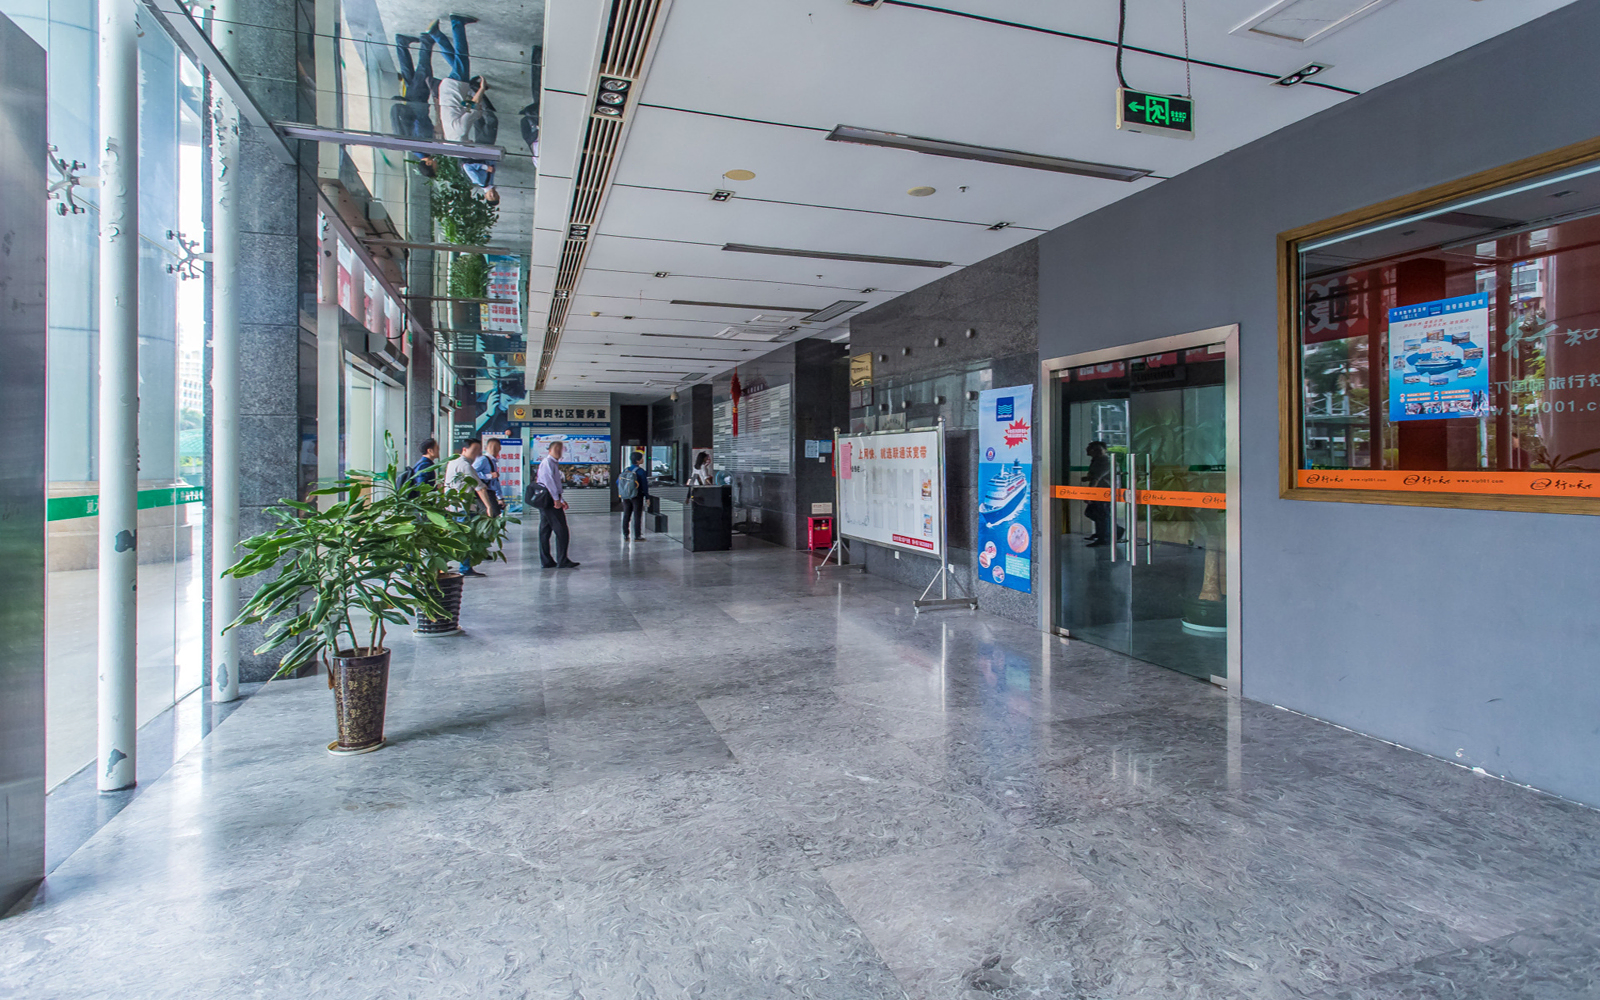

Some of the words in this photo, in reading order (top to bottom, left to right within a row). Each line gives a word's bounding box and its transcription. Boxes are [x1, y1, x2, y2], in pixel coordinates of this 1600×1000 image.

[532, 408, 606, 419] 国贸社区警务室
[1490, 401, 1600, 418] w.vip001.c
